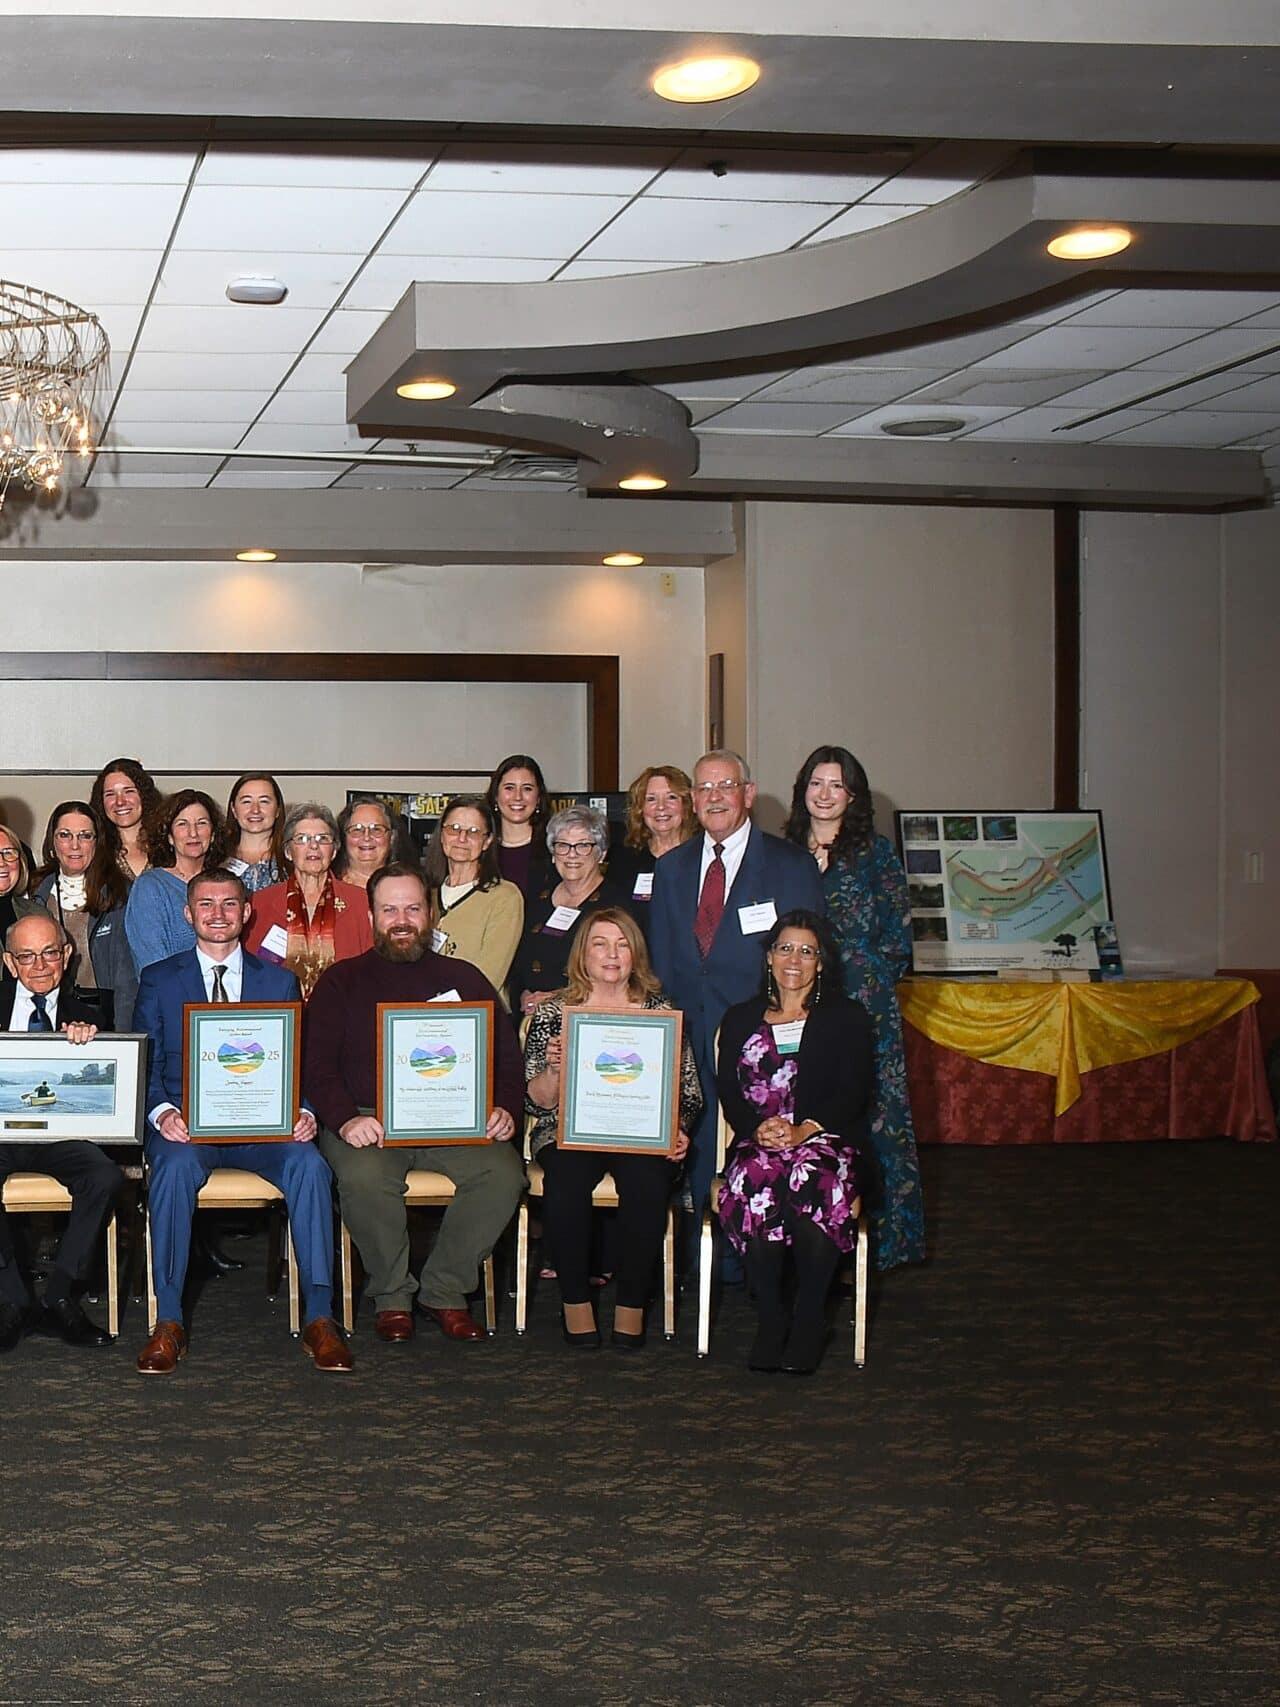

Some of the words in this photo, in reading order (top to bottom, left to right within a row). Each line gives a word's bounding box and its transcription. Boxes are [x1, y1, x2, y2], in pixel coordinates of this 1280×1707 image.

[416, 796, 449, 815] SALT
[202, 1051, 216, 1061] 20
[267, 1050, 280, 1060] 25
